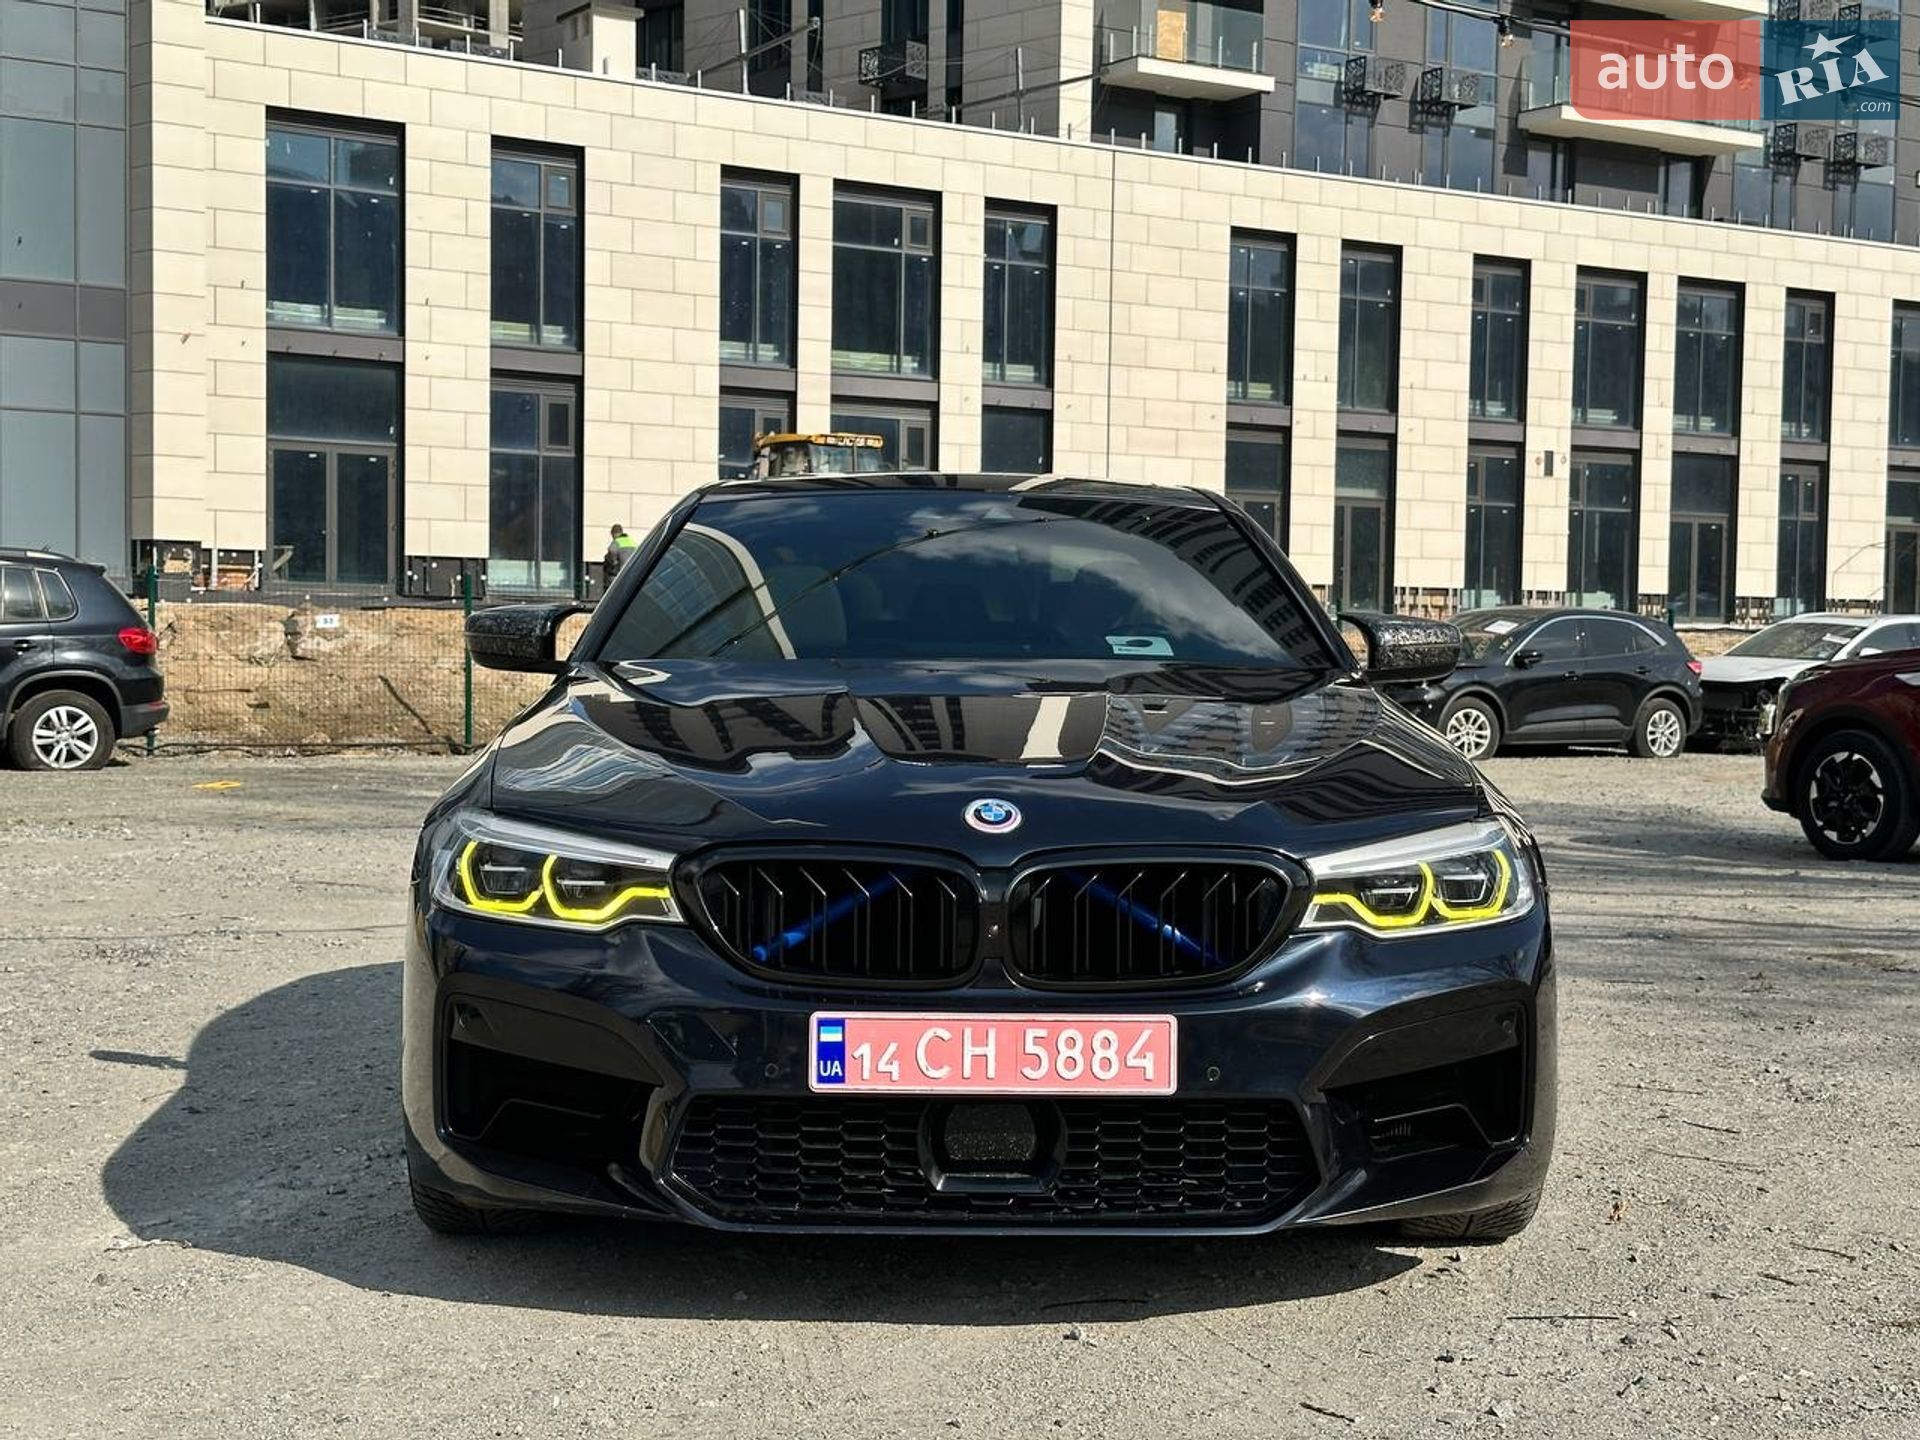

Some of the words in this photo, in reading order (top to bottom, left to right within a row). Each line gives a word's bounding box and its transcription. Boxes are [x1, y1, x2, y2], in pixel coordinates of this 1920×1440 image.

[819, 1060, 843, 1076] UA
[851, 1042, 900, 1081] 14
[915, 1027, 996, 1080] CH
[1020, 1028, 1155, 1080] 5884
